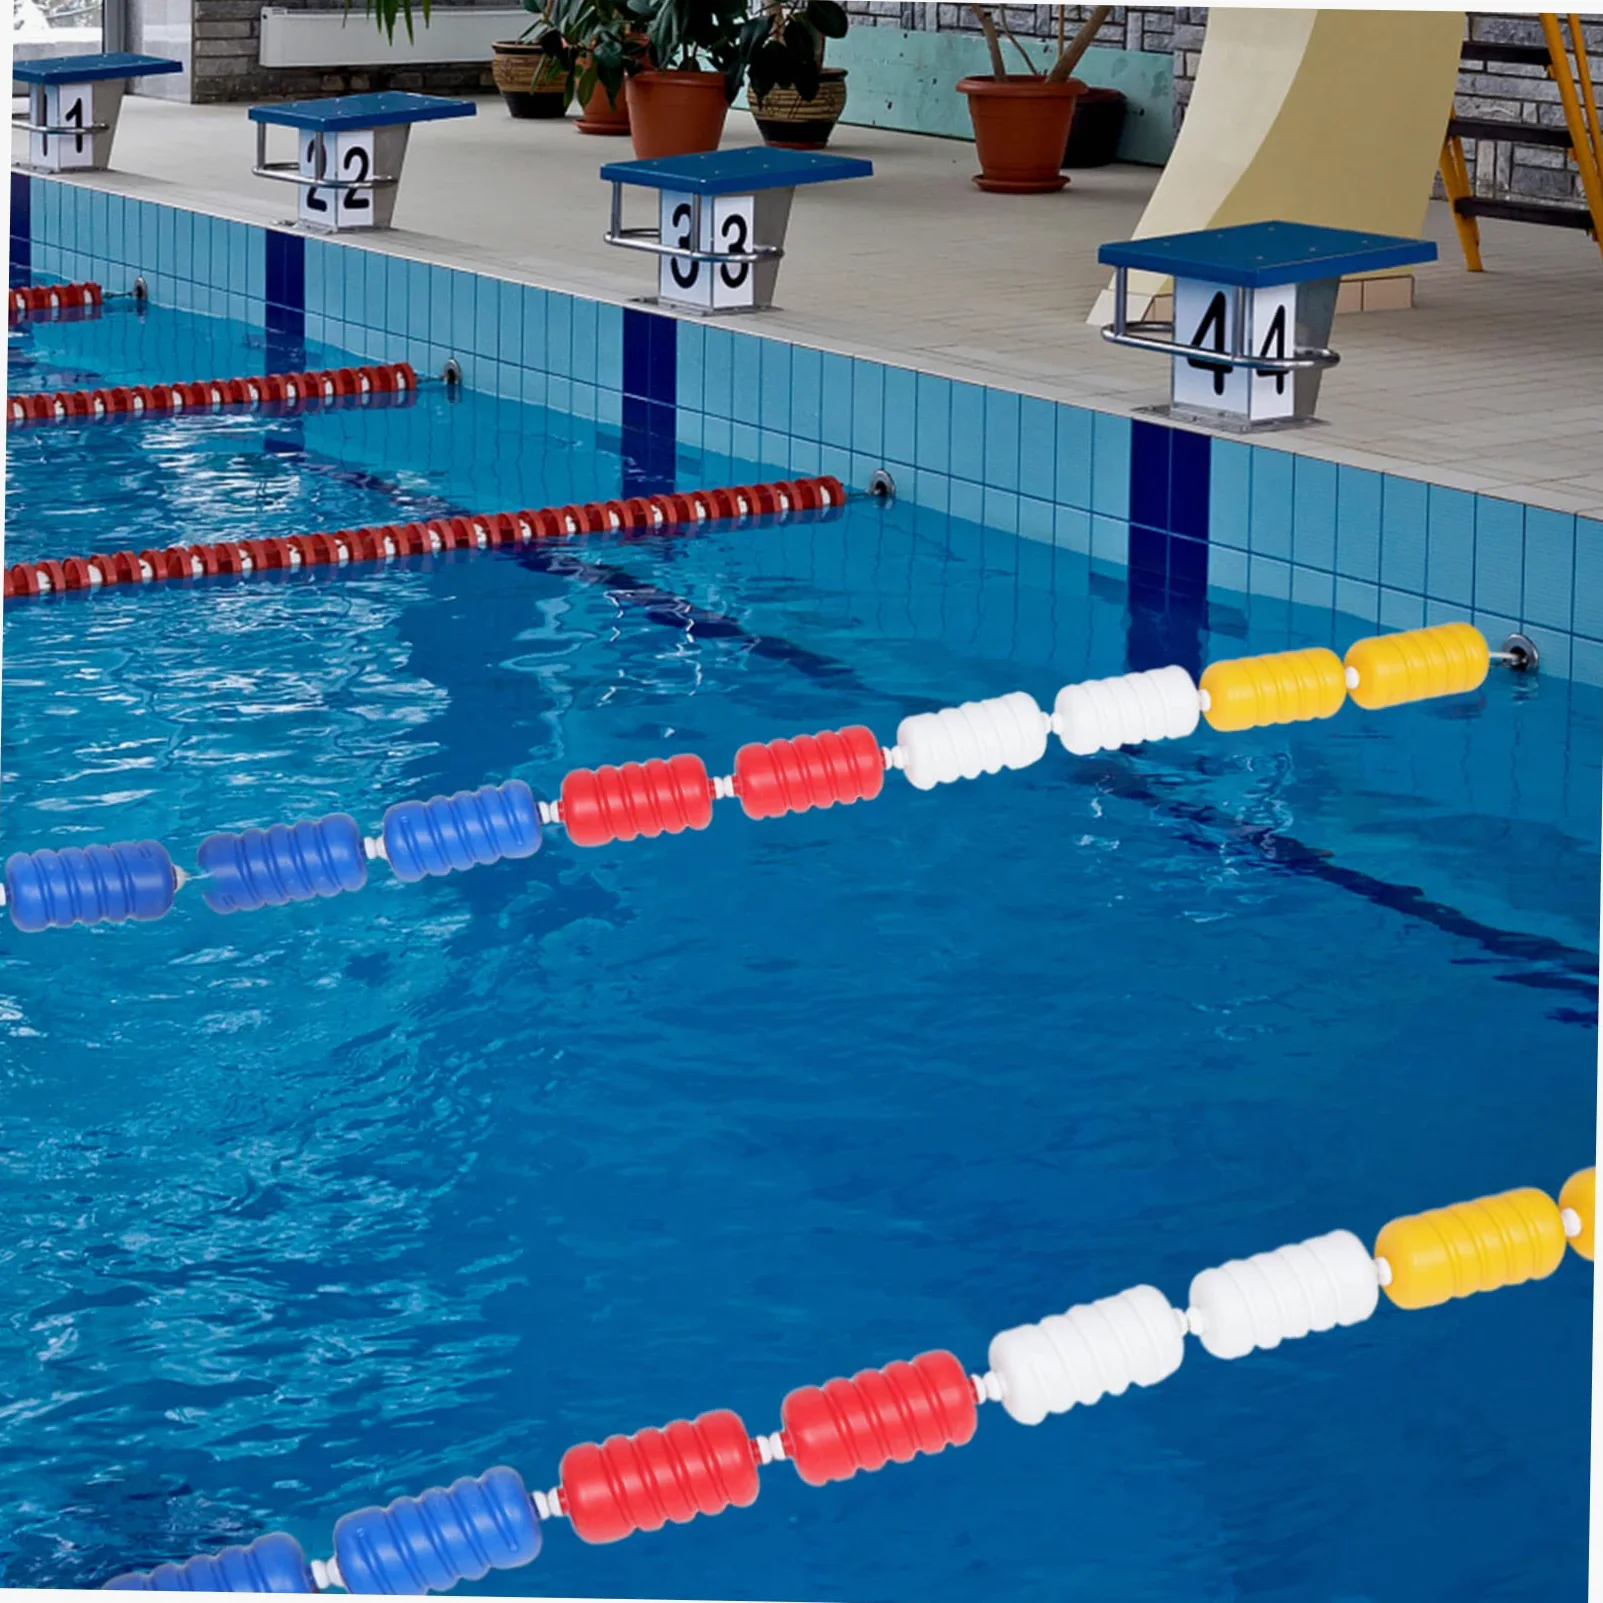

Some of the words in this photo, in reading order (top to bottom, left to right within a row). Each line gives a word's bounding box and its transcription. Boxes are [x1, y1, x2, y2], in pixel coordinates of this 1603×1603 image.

[65, 97, 83, 154] 1
[306, 139, 328, 213] 2
[343, 146, 370, 211] 2
[670, 203, 700, 289] 3
[720, 213, 750, 289] 3
[1187, 290, 1234, 396] 4
[1256, 304, 1290, 396] 4
